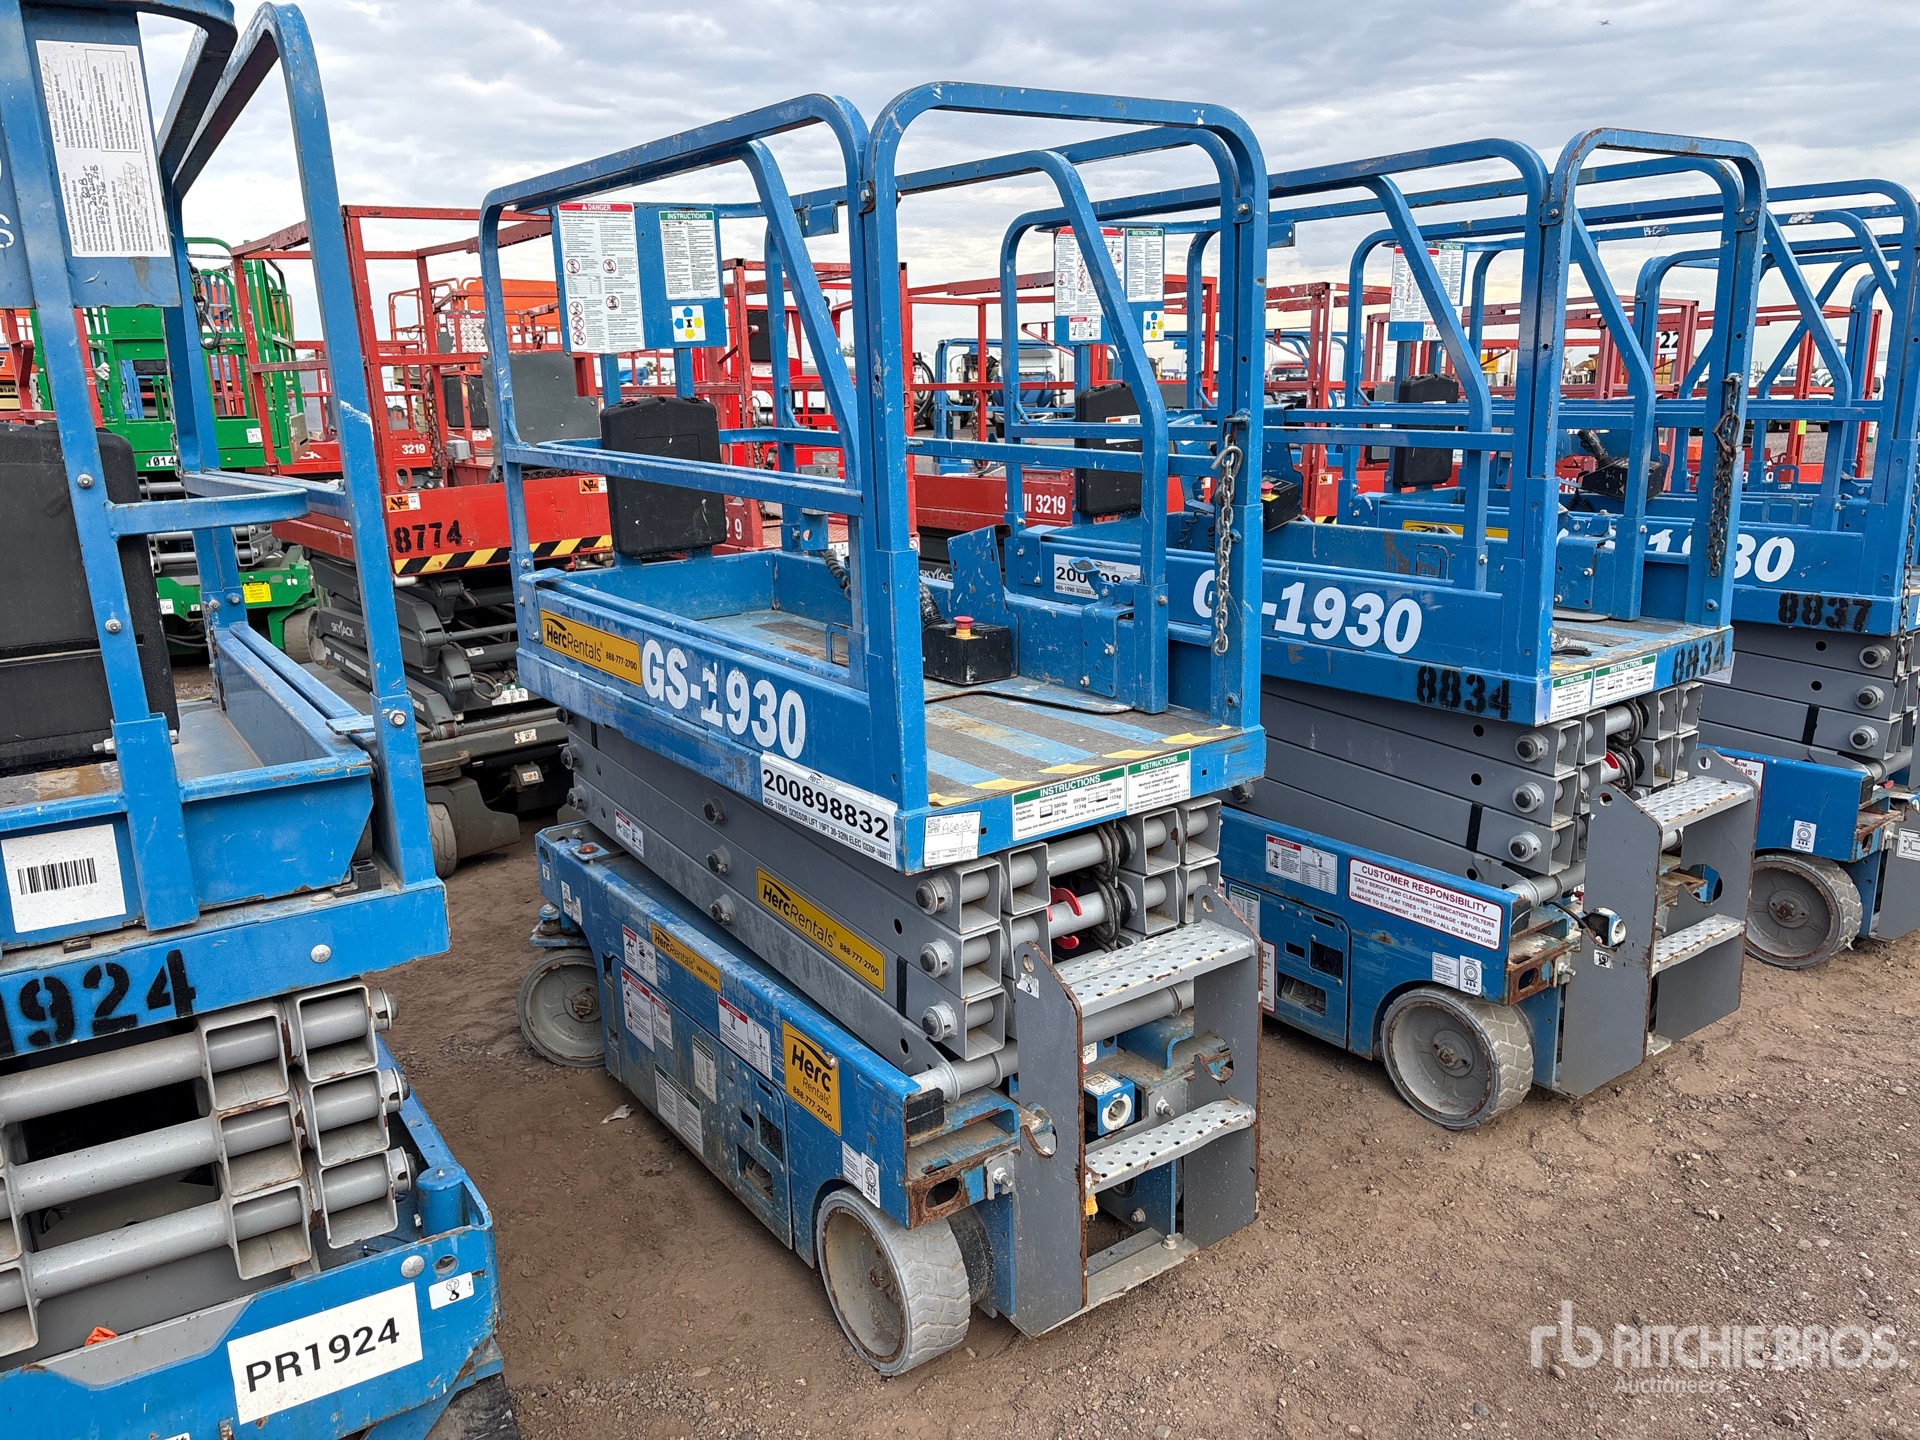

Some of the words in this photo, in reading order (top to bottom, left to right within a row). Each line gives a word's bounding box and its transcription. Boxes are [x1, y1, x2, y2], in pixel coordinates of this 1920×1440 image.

[402, 444, 426, 454] 3219
[1036, 494, 1066, 515] 3219
[394, 520, 462, 553] 8774
[331, 620, 354, 638] SKYJACK
[1778, 592, 1872, 632] 8837
[1560, 674, 1584, 685] INSTRUCTIONS
[1609, 661, 1643, 674] INSTRUCTIONS
[642, 639, 806, 759] GS-1930
[1417, 666, 1510, 721] 8834
[1140, 757, 1178, 771] INSTRUCTIONS
[1040, 775, 1100, 797] INSTRUCTIONS
[763, 769, 890, 842] 200898832
[808, 816, 817, 828] LIFT
[1354, 877, 1367, 885] DAILY
[1369, 881, 1389, 892] SERVICE
[1390, 888, 1401, 896] AND
[1402, 893, 1428, 906] CLEANING
[1432, 903, 1467, 919] LUBRICATION
[1472, 916, 1494, 928] FILTERS
[1362, 866, 1409, 888] CUSTOMER
[1412, 882, 1488, 913] RESPONSIBILITY
[1350, 891, 1371, 903] DAMAGE
[1372, 898, 1379, 906] TO
[1380, 901, 1408, 916] EQUIPMENT
[1412, 912, 1435, 925] BATTERY
[1440, 921, 1449, 930] ALL
[1452, 925, 1463, 934] OILS
[1464, 929, 1476, 939] AND
[1477, 934, 1496, 946] FLUIDS
[1356, 885, 1384, 899] INSURANCE
[1388, 896, 1400, 904] FLAT
[1402, 900, 1416, 909] TIRES
[1420, 906, 1431, 914] TIRE
[1433, 910, 1456, 923] DAMAGE
[1460, 920, 1491, 934] REFUELING
[840, 942, 880, 977] 888-777-2700
[0, 949, 197, 1056] 1924
[791, 1043, 832, 1093] Herc
[792, 1086, 832, 1122] 888-777-2700
[802, 1077, 830, 1106] Rentals
[246, 1317, 400, 1393] PR1924
